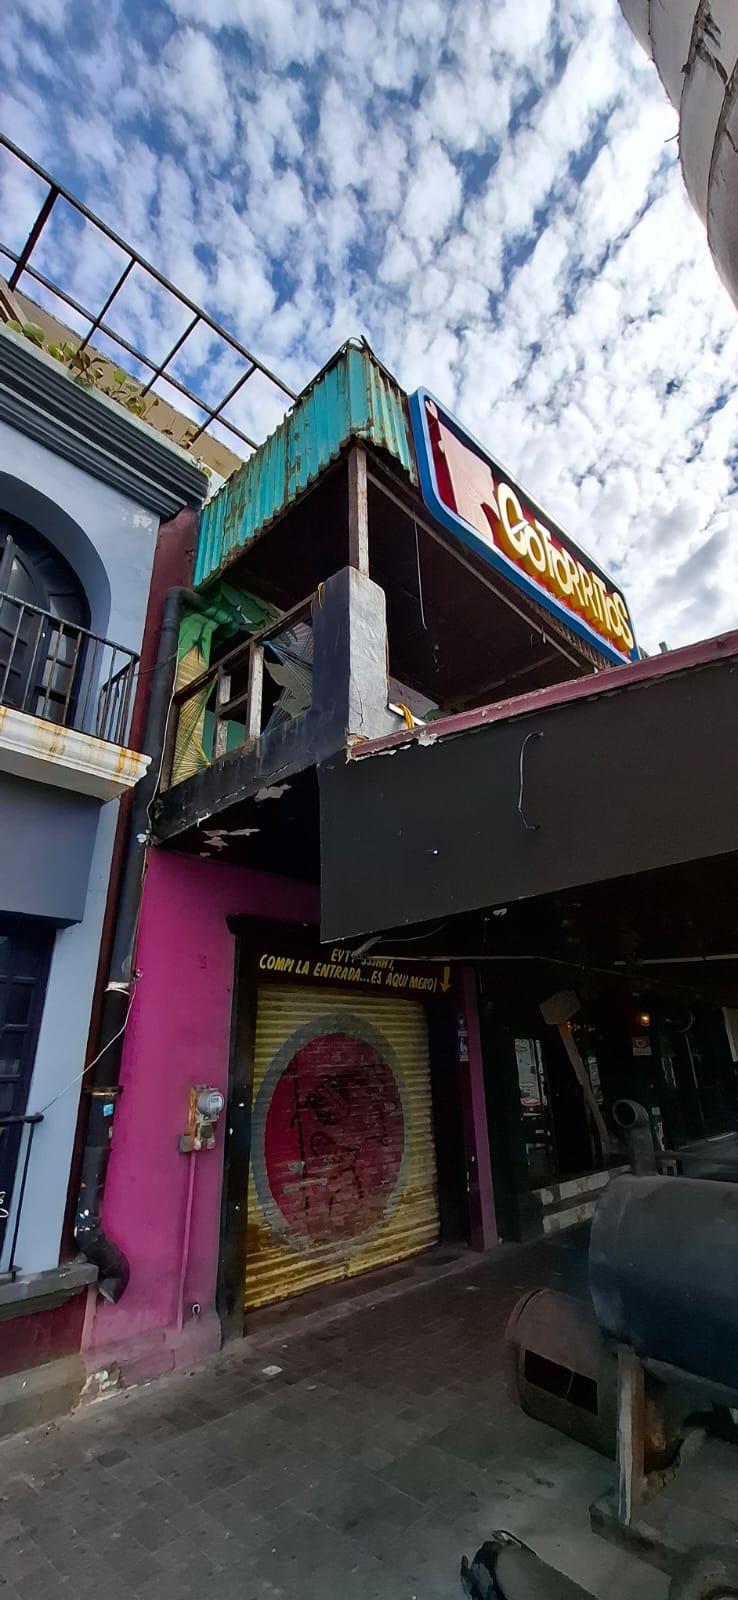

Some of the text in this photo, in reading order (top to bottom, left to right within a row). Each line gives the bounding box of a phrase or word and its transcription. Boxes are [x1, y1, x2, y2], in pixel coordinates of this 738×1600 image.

[259, 953, 292, 973] COMPI
[295, 960, 309, 975] LA
[385, 972, 408, 988] AQUI
